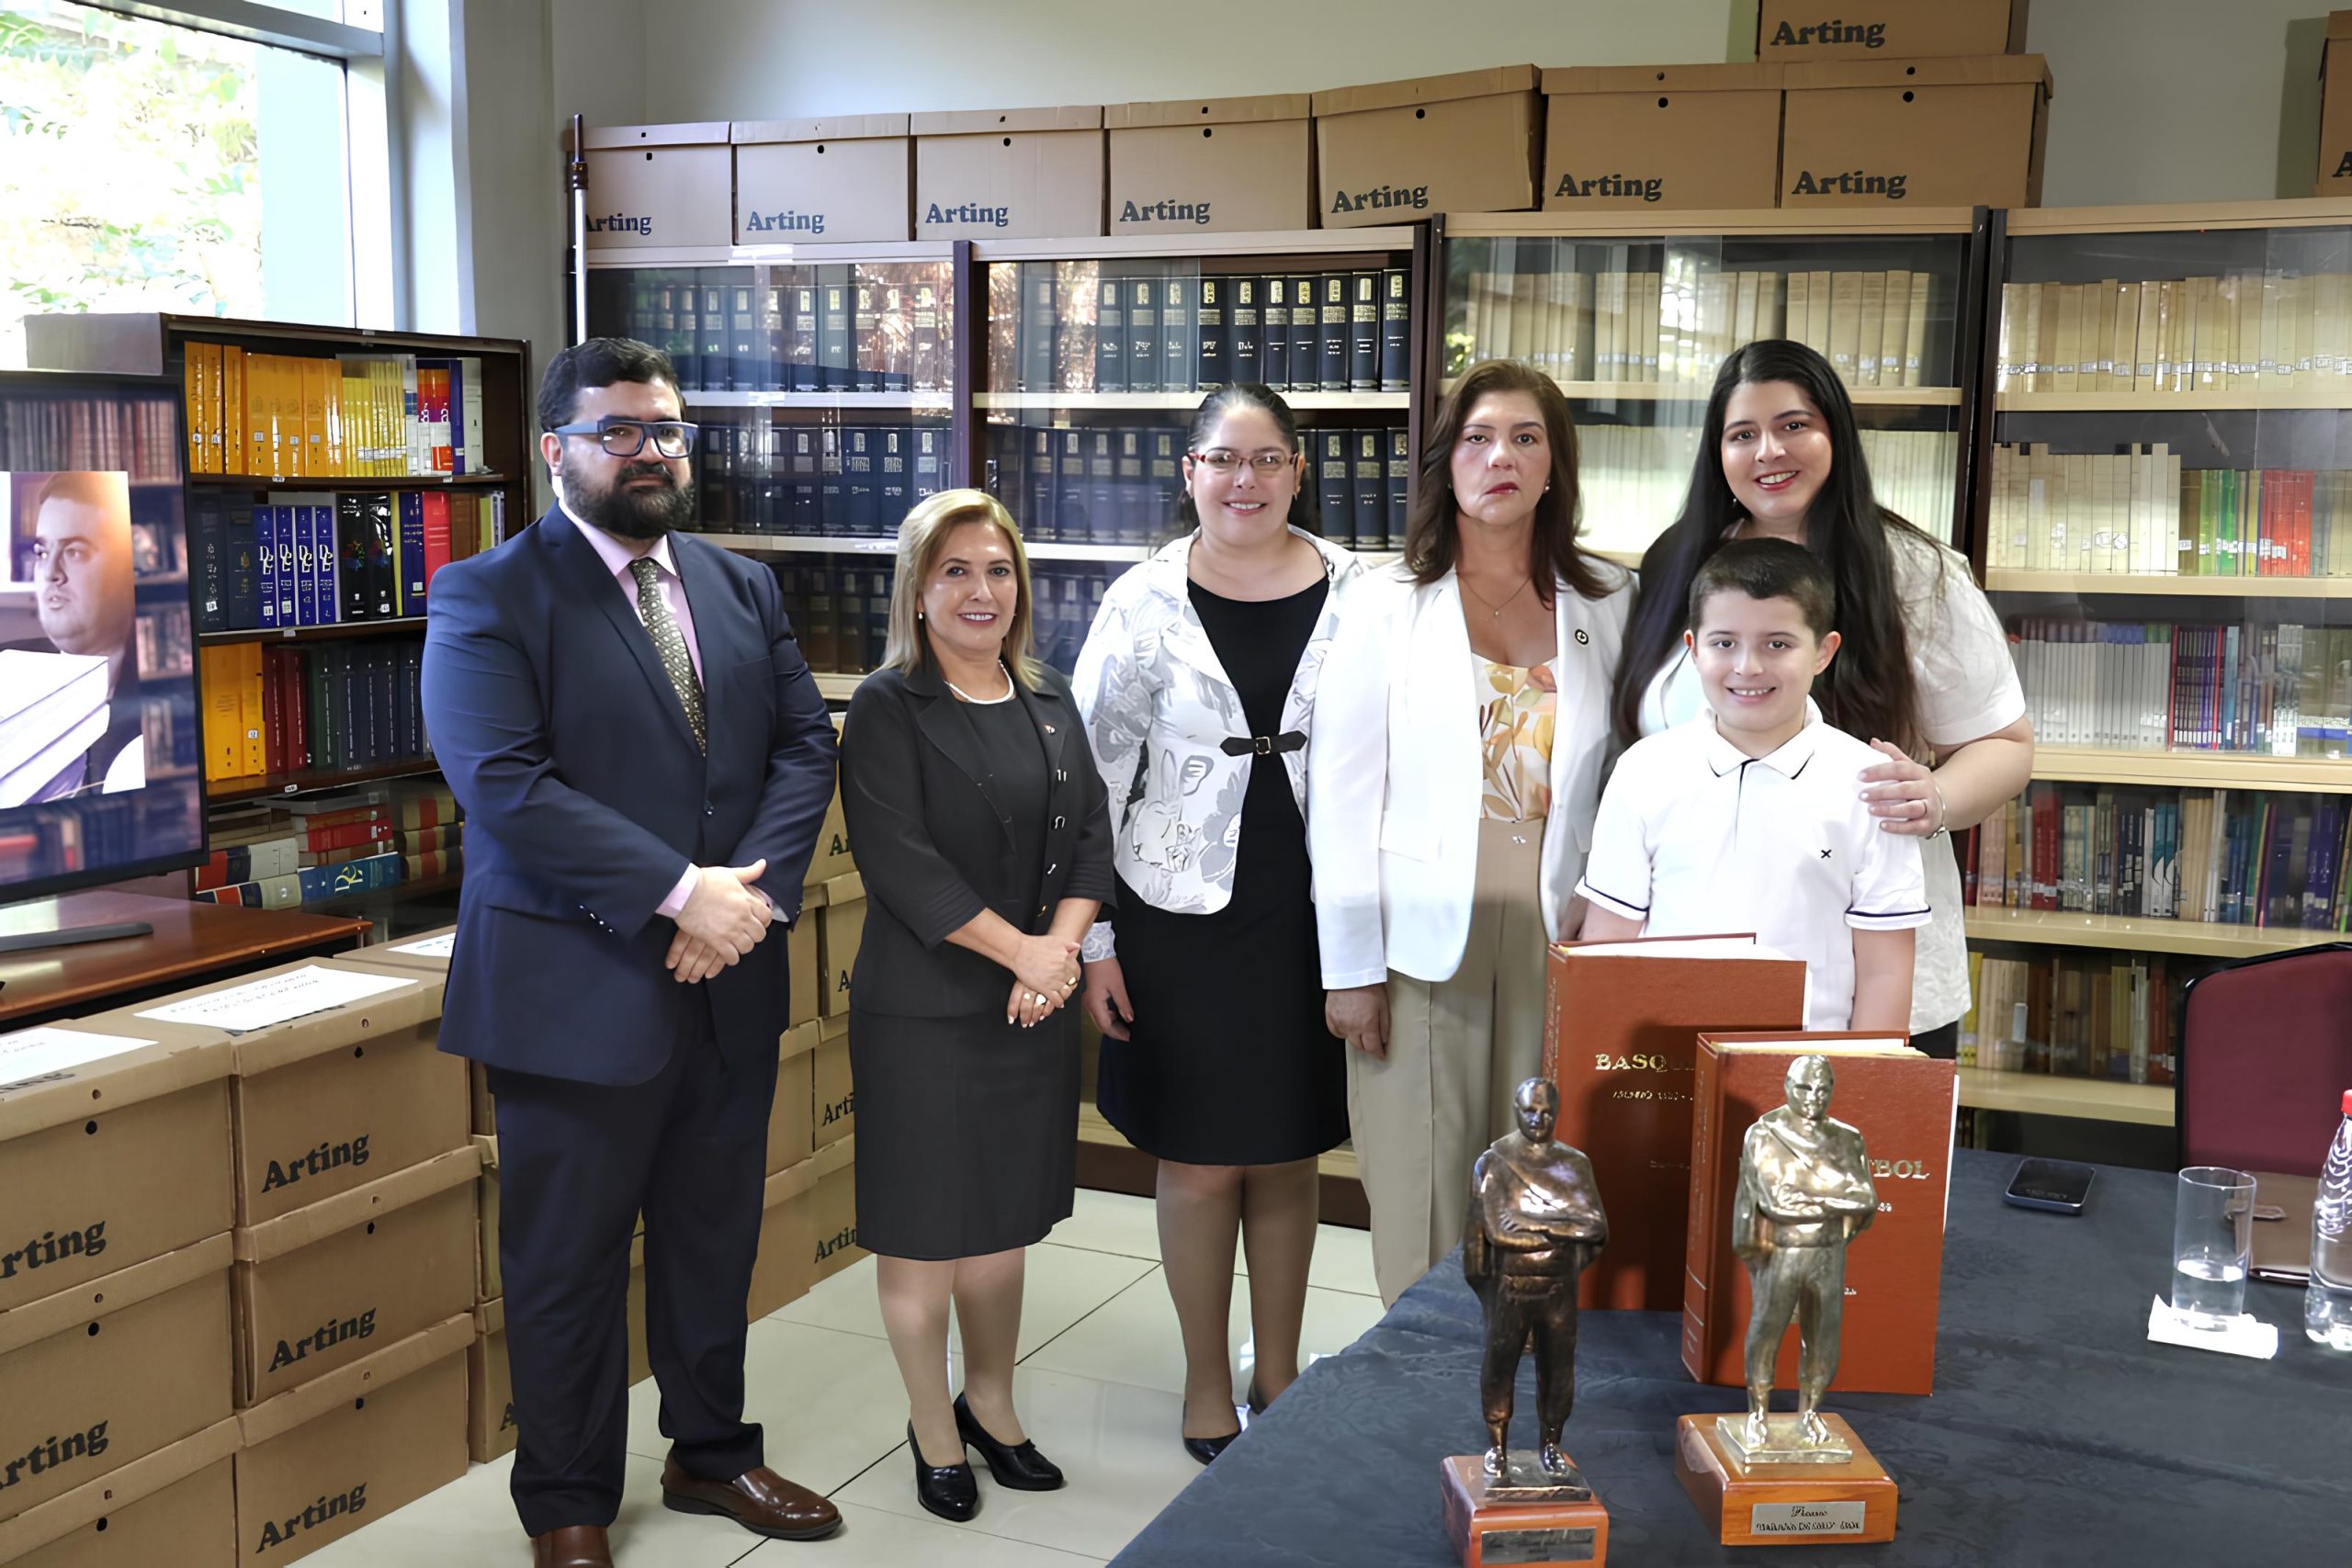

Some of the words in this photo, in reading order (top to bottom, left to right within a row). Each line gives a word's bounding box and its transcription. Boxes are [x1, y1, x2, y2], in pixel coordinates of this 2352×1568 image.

[1770, 19, 1885, 49] Arting
[1331, 186, 1429, 214] Arting
[1555, 173, 1663, 203] Arting
[1792, 170, 1906, 200] Arting
[746, 210, 825, 235] Arting
[925, 202, 1009, 228] Arting
[1120, 198, 1211, 225] Arting
[822, 1092, 854, 1127] Arti
[262, 1134, 369, 1194] Arting
[1870, 1159, 1930, 1179] BOL
[0, 1220, 107, 1279] rting
[814, 1227, 856, 1264] Arti
[268, 1307, 377, 1373] Arting
[0, 1420, 109, 1489] rting
[255, 1482, 368, 1554] Arting
